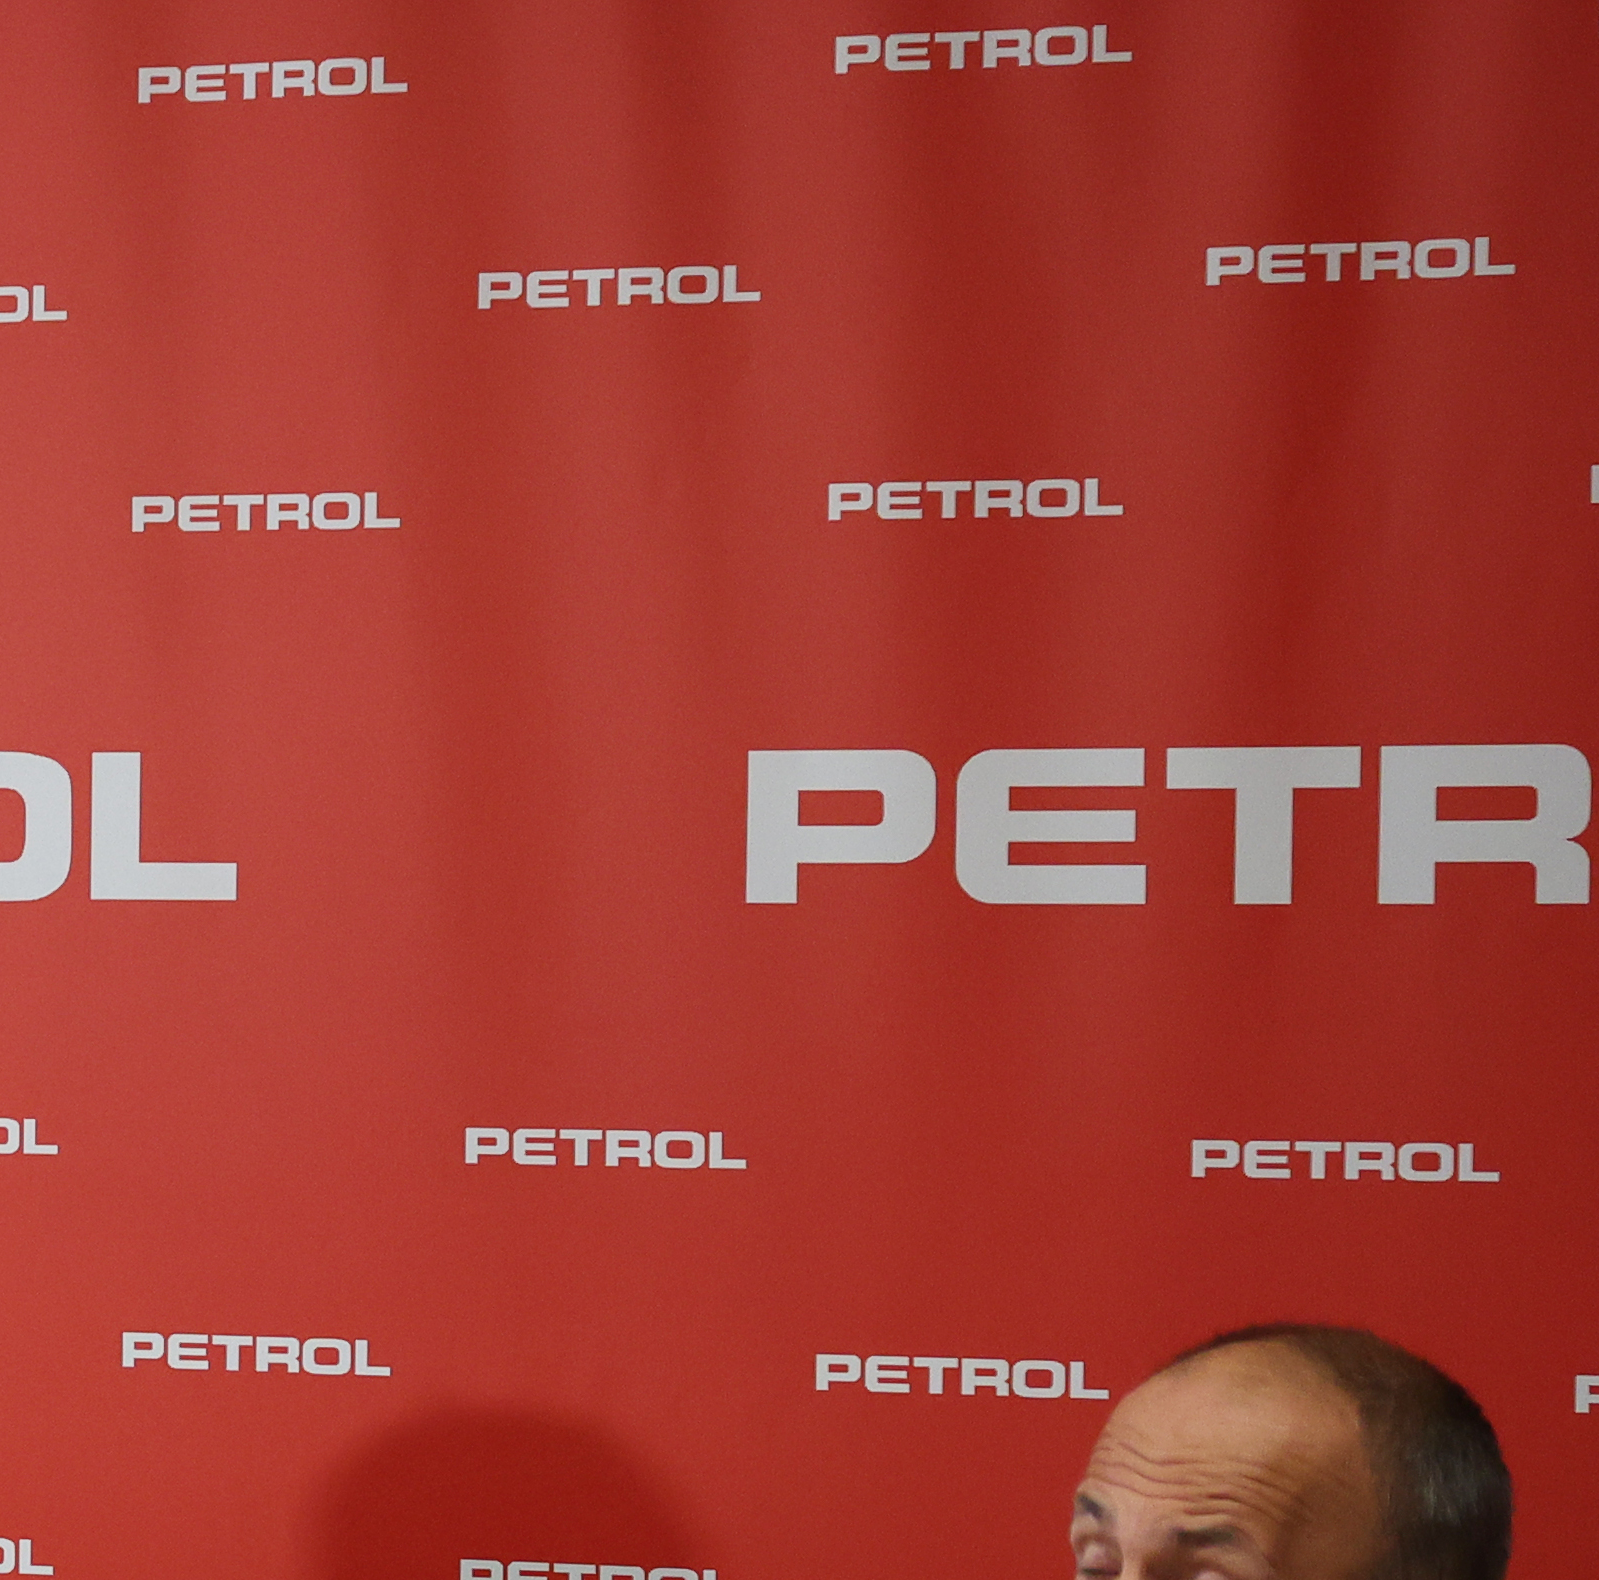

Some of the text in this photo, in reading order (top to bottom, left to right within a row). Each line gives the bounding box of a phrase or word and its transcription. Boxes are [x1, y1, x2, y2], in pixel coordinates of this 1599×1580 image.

[836, 25, 1131, 74] PETROL
[138, 57, 407, 103] PETROL
[1206, 237, 1515, 285] PETROL
[478, 266, 760, 309] PETROL
[132, 492, 400, 532] PETROL
[828, 478, 1123, 520] PETROL
[746, 744, 1591, 904] PETR
[465, 1128, 746, 1169] PETROL
[1192, 1140, 1499, 1181] PETROL
[122, 1332, 390, 1376] PETROL
[816, 1354, 1109, 1399] PETROL
